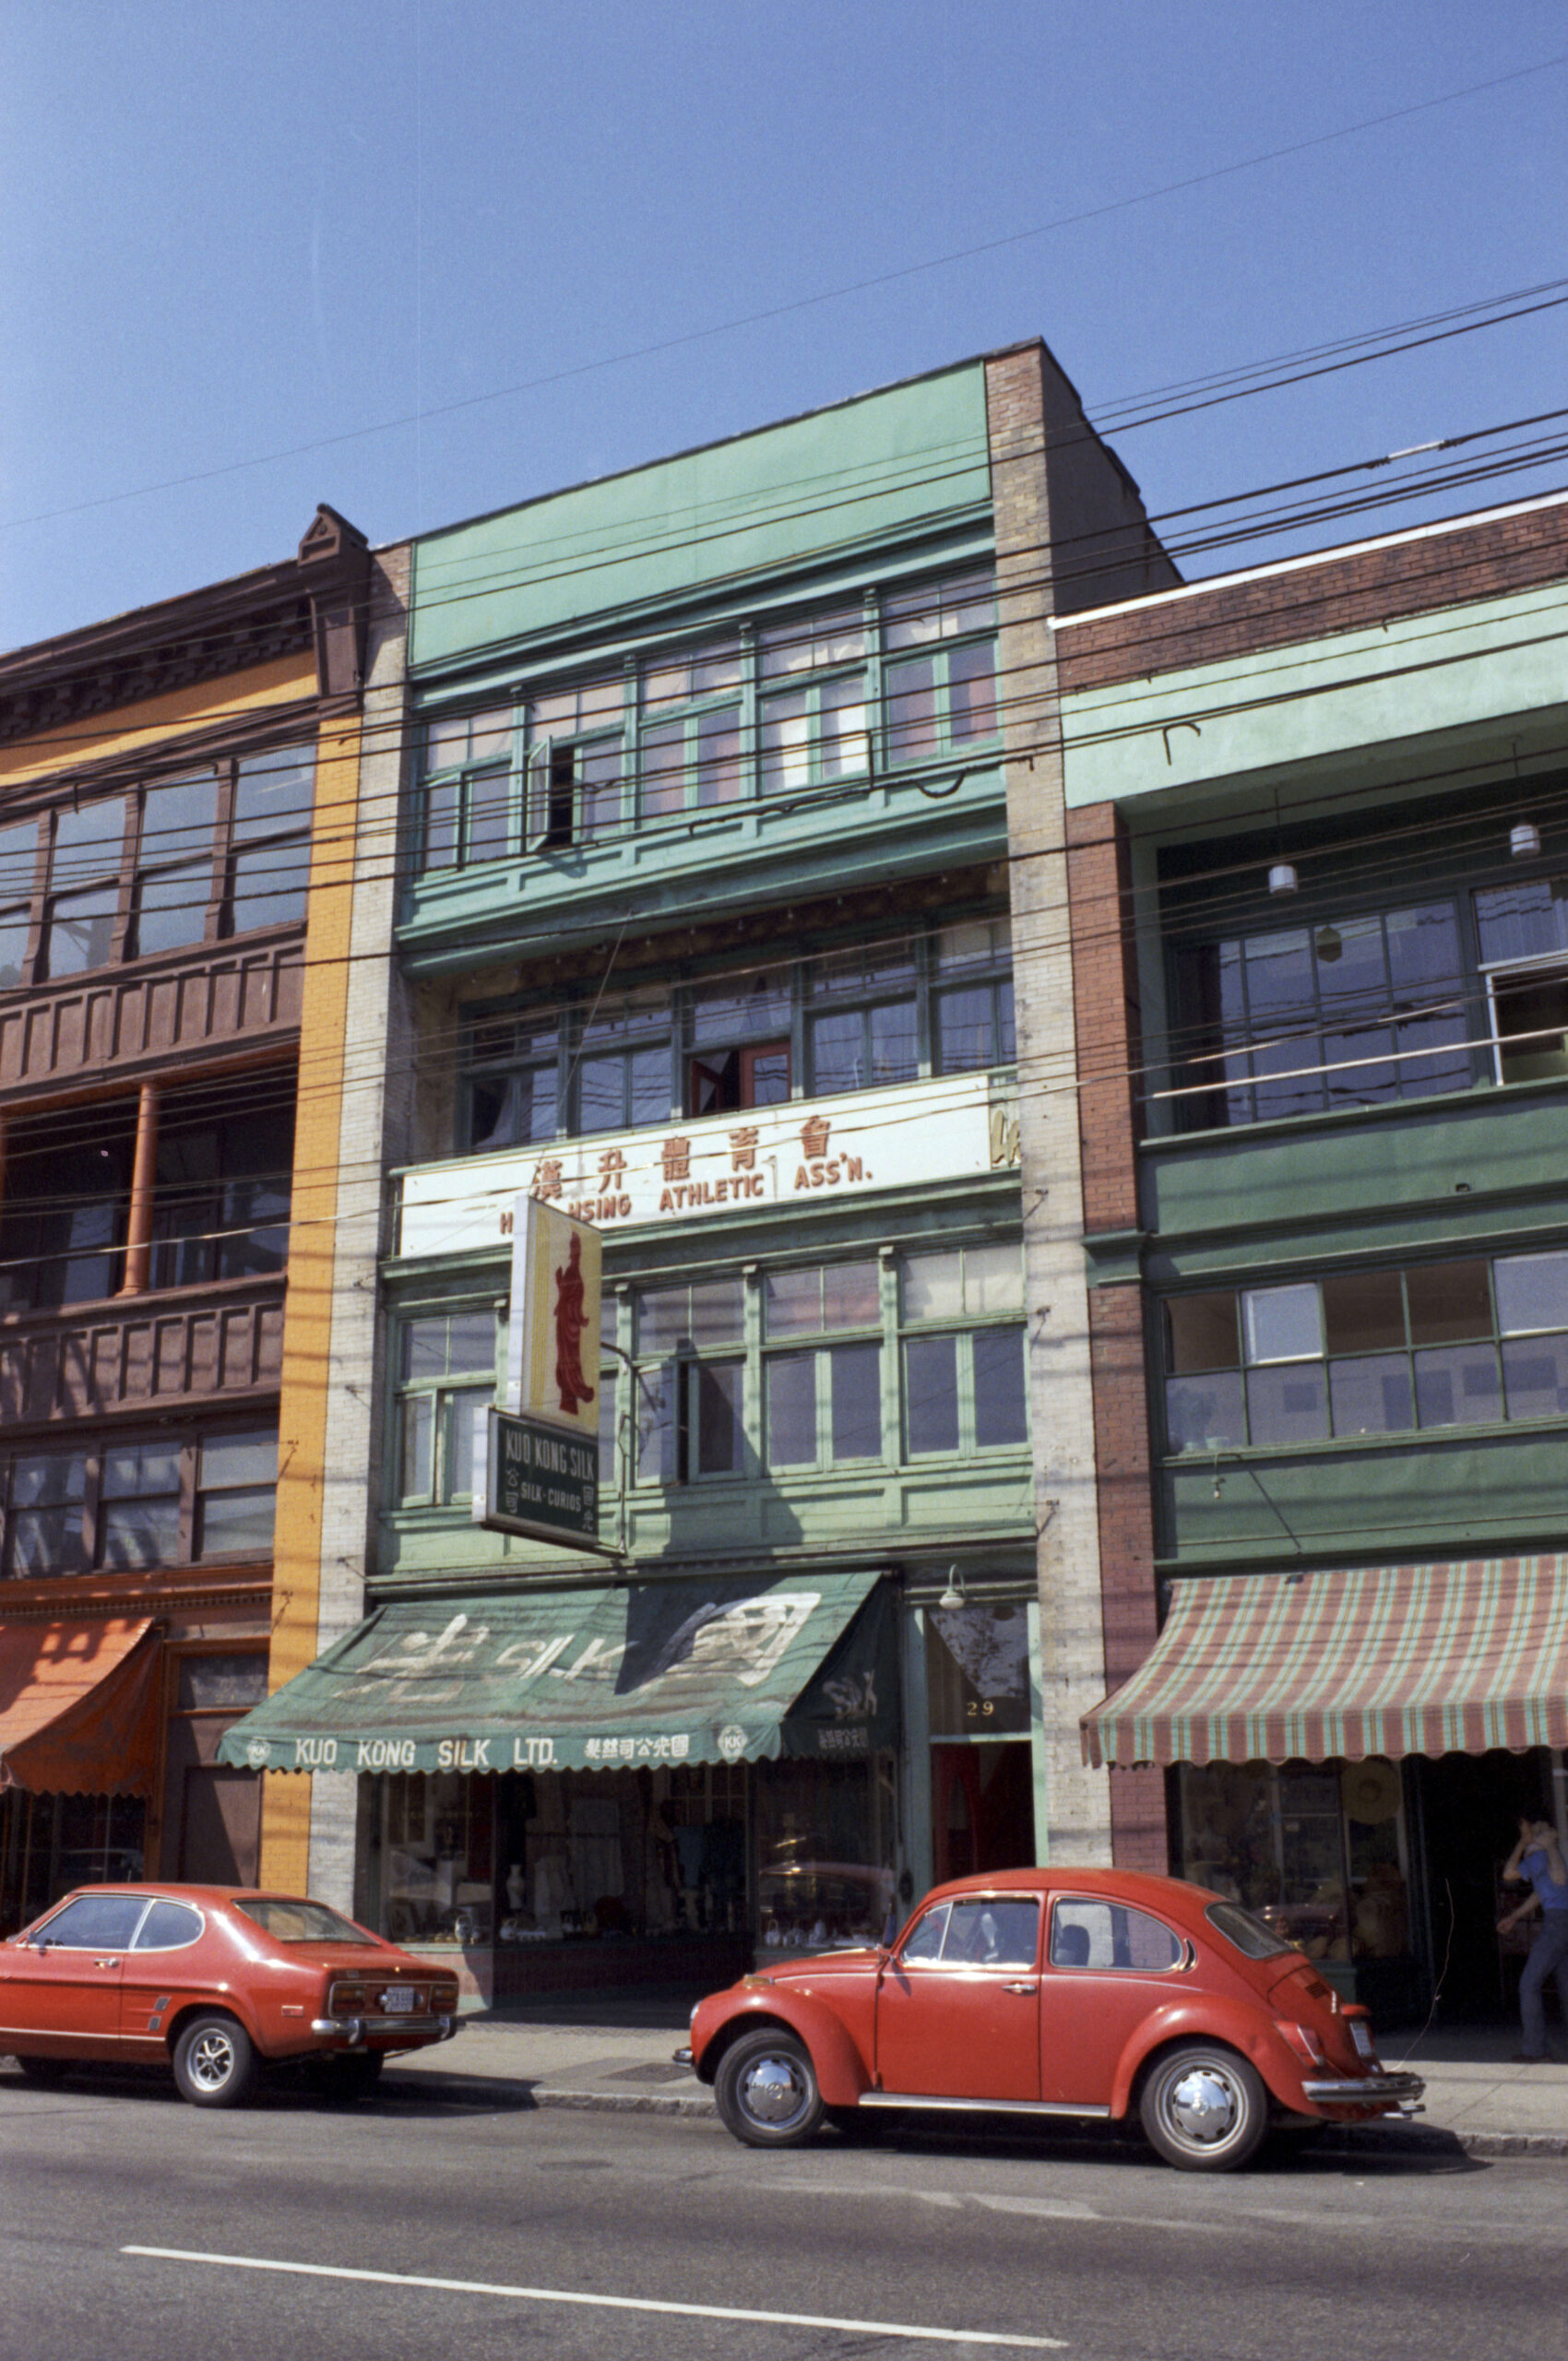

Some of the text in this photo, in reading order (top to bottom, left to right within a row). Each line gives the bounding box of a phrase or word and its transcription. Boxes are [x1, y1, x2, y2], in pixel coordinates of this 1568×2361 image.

[568, 1152, 873, 1222] HSING ATHLETIC ASS'N.
[505, 1429, 595, 1482] KUO KONG SILK
[520, 1481, 582, 1513] SILK CURIOS
[494, 1632, 639, 1681] SILK
[966, 1701, 995, 1716] 29
[295, 1738, 558, 1767] KUO KONG SILK LTD.
